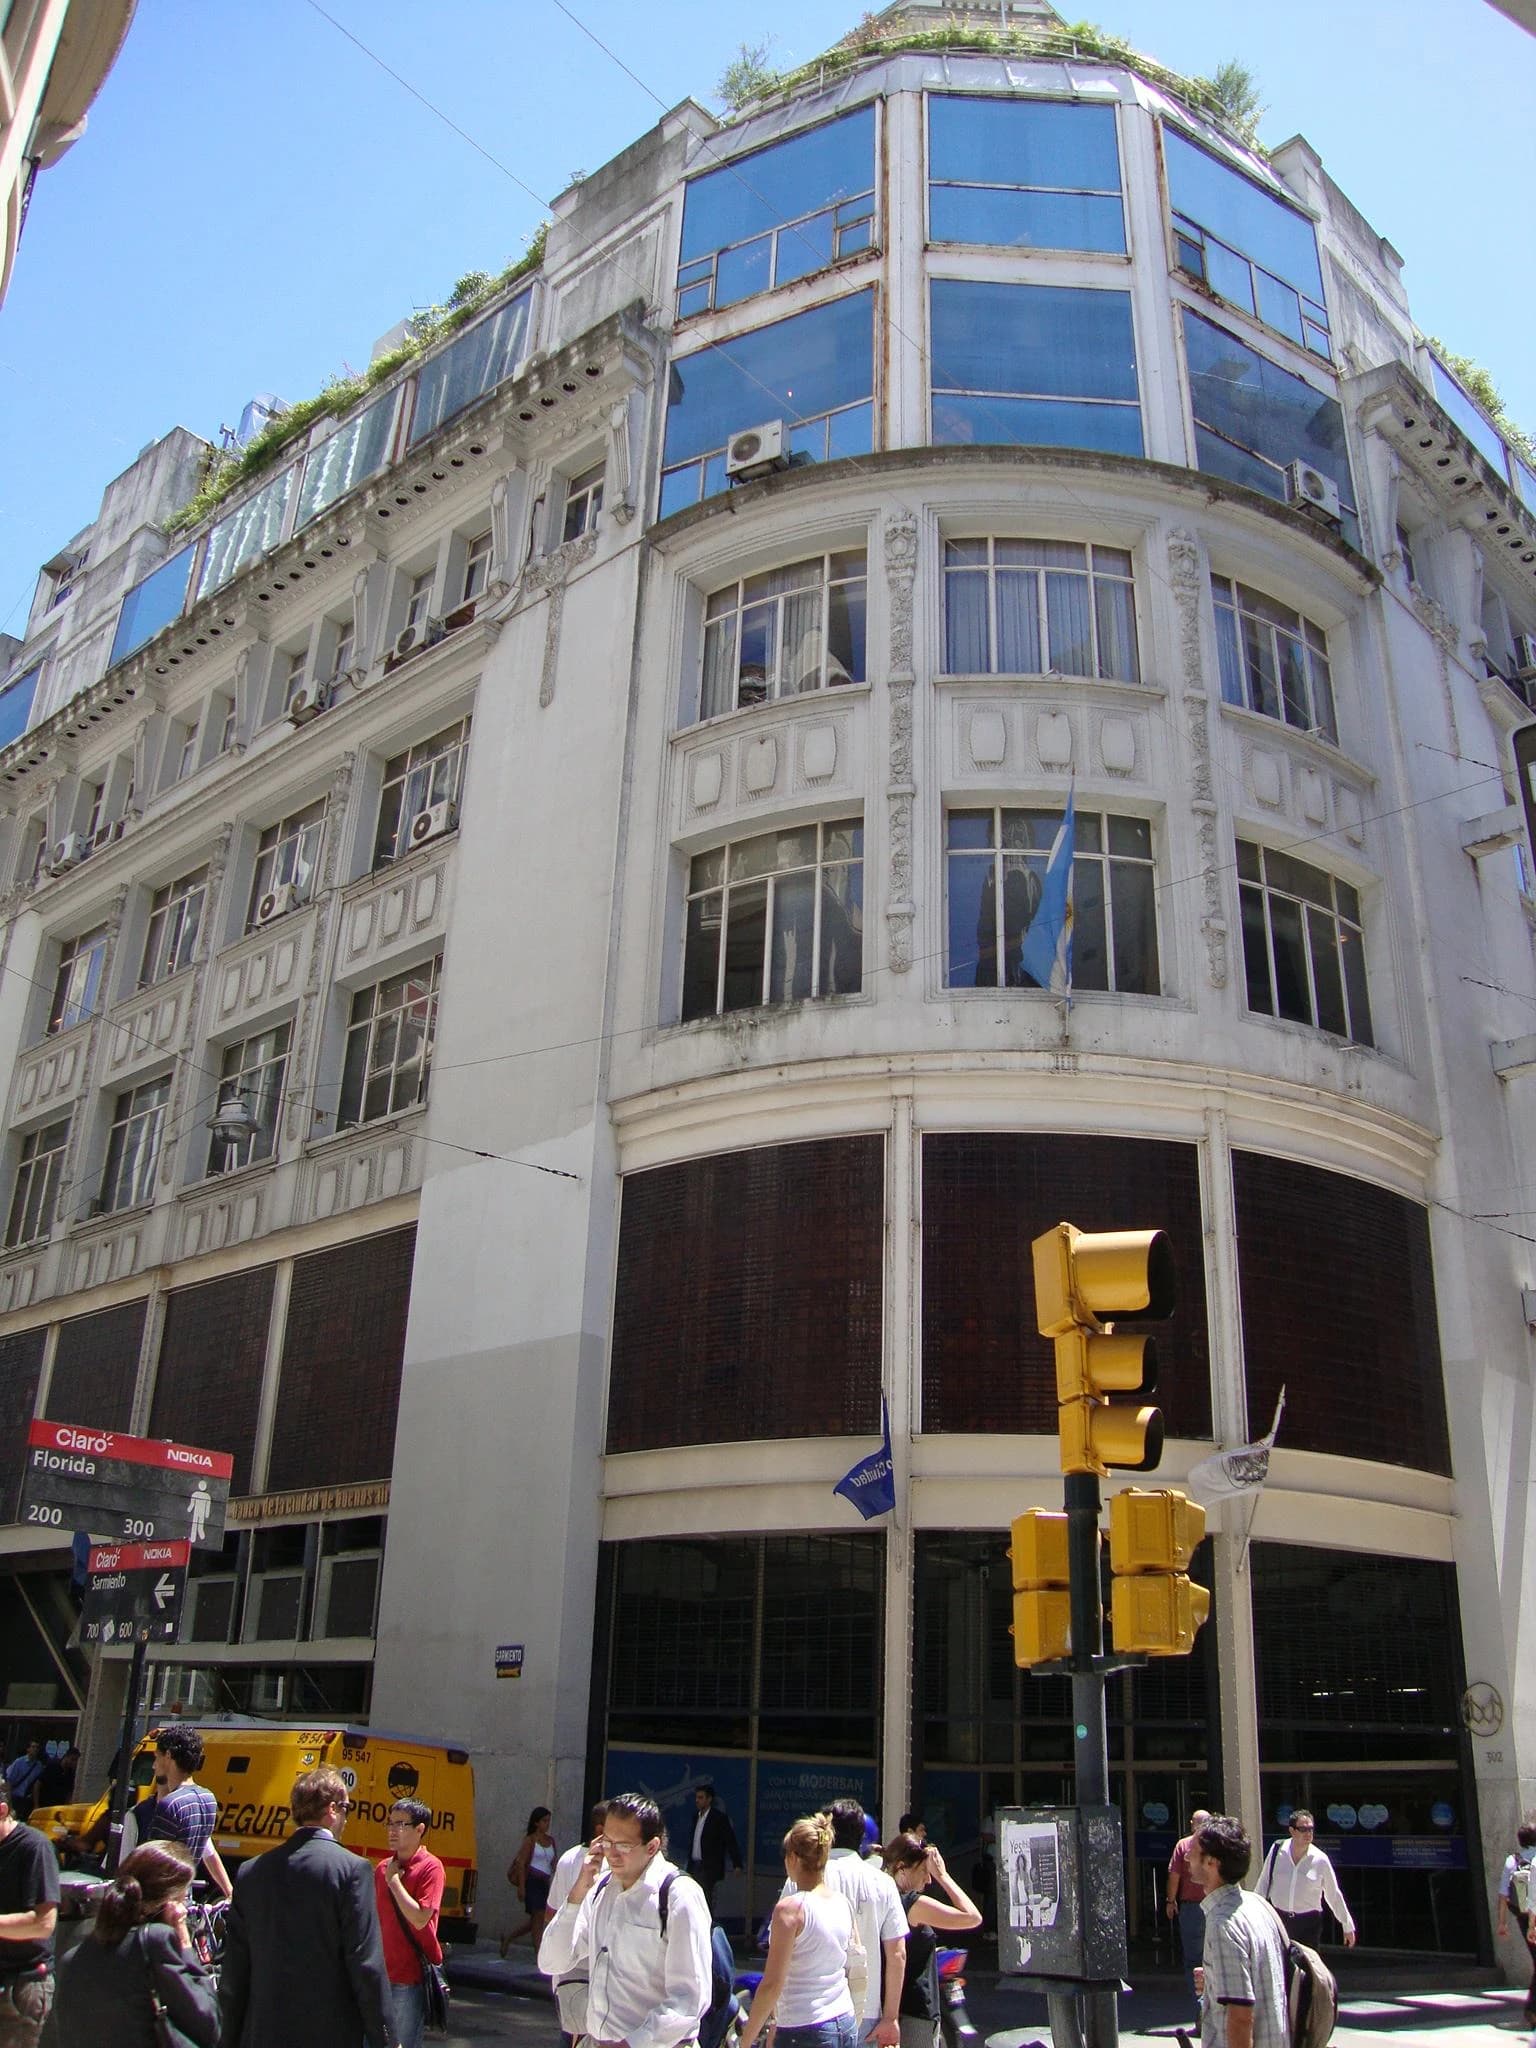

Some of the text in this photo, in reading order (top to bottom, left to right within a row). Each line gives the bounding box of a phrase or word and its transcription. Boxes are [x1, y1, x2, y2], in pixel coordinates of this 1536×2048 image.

[56, 1428, 108, 1453] Claro
[33, 1450, 96, 1475] Florida
[167, 1449, 213, 1468] NOKIA
[285, 1491, 319, 1513] ciudad
[335, 1487, 372, 1508] buenos
[28, 1504, 155, 1538] 200 300
[96, 1551, 118, 1568] Claro
[143, 1547, 172, 1560] NOKIA
[92, 1572, 126, 1590] Sarmiento
[87, 1621, 133, 1639] 700 600
[342, 1748, 371, 1764] 95 547
[348, 1798, 455, 1831] PROUR
[1009, 1840, 1023, 1854] Yes
